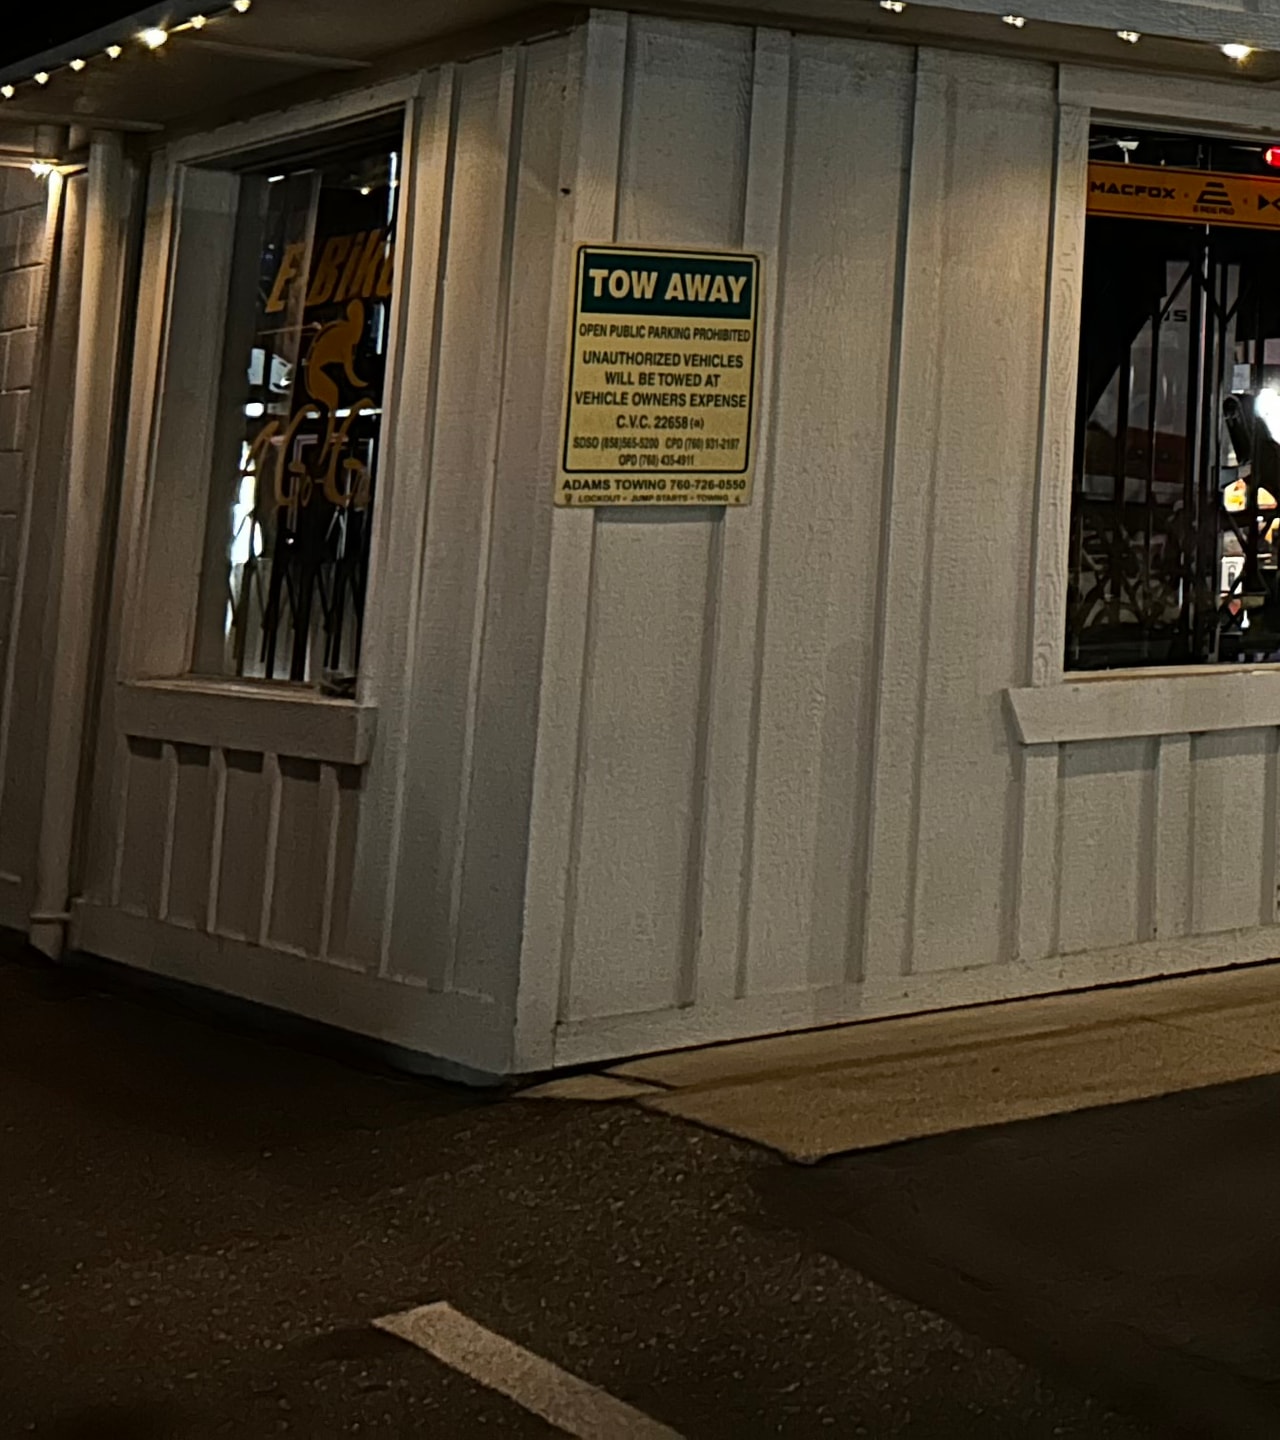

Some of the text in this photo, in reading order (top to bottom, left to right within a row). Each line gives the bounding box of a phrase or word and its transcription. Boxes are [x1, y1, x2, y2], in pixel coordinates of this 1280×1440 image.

[1089, 180, 1177, 200] MACFOX
[588, 268, 748, 304] TOW AWAY
[579, 323, 750, 343] OPEN PUBLIC PARKING PROHIBITED
[582, 350, 744, 369] UNAUTHORIZED VEHICLES
[605, 371, 721, 388] WILL BE TOWED AT
[575, 391, 747, 409] VEHICLE OWNERS EXPENSE
[616, 414, 651, 430] C.V.C.
[562, 479, 747, 491] ADAMS TOWING 760-726-0550
